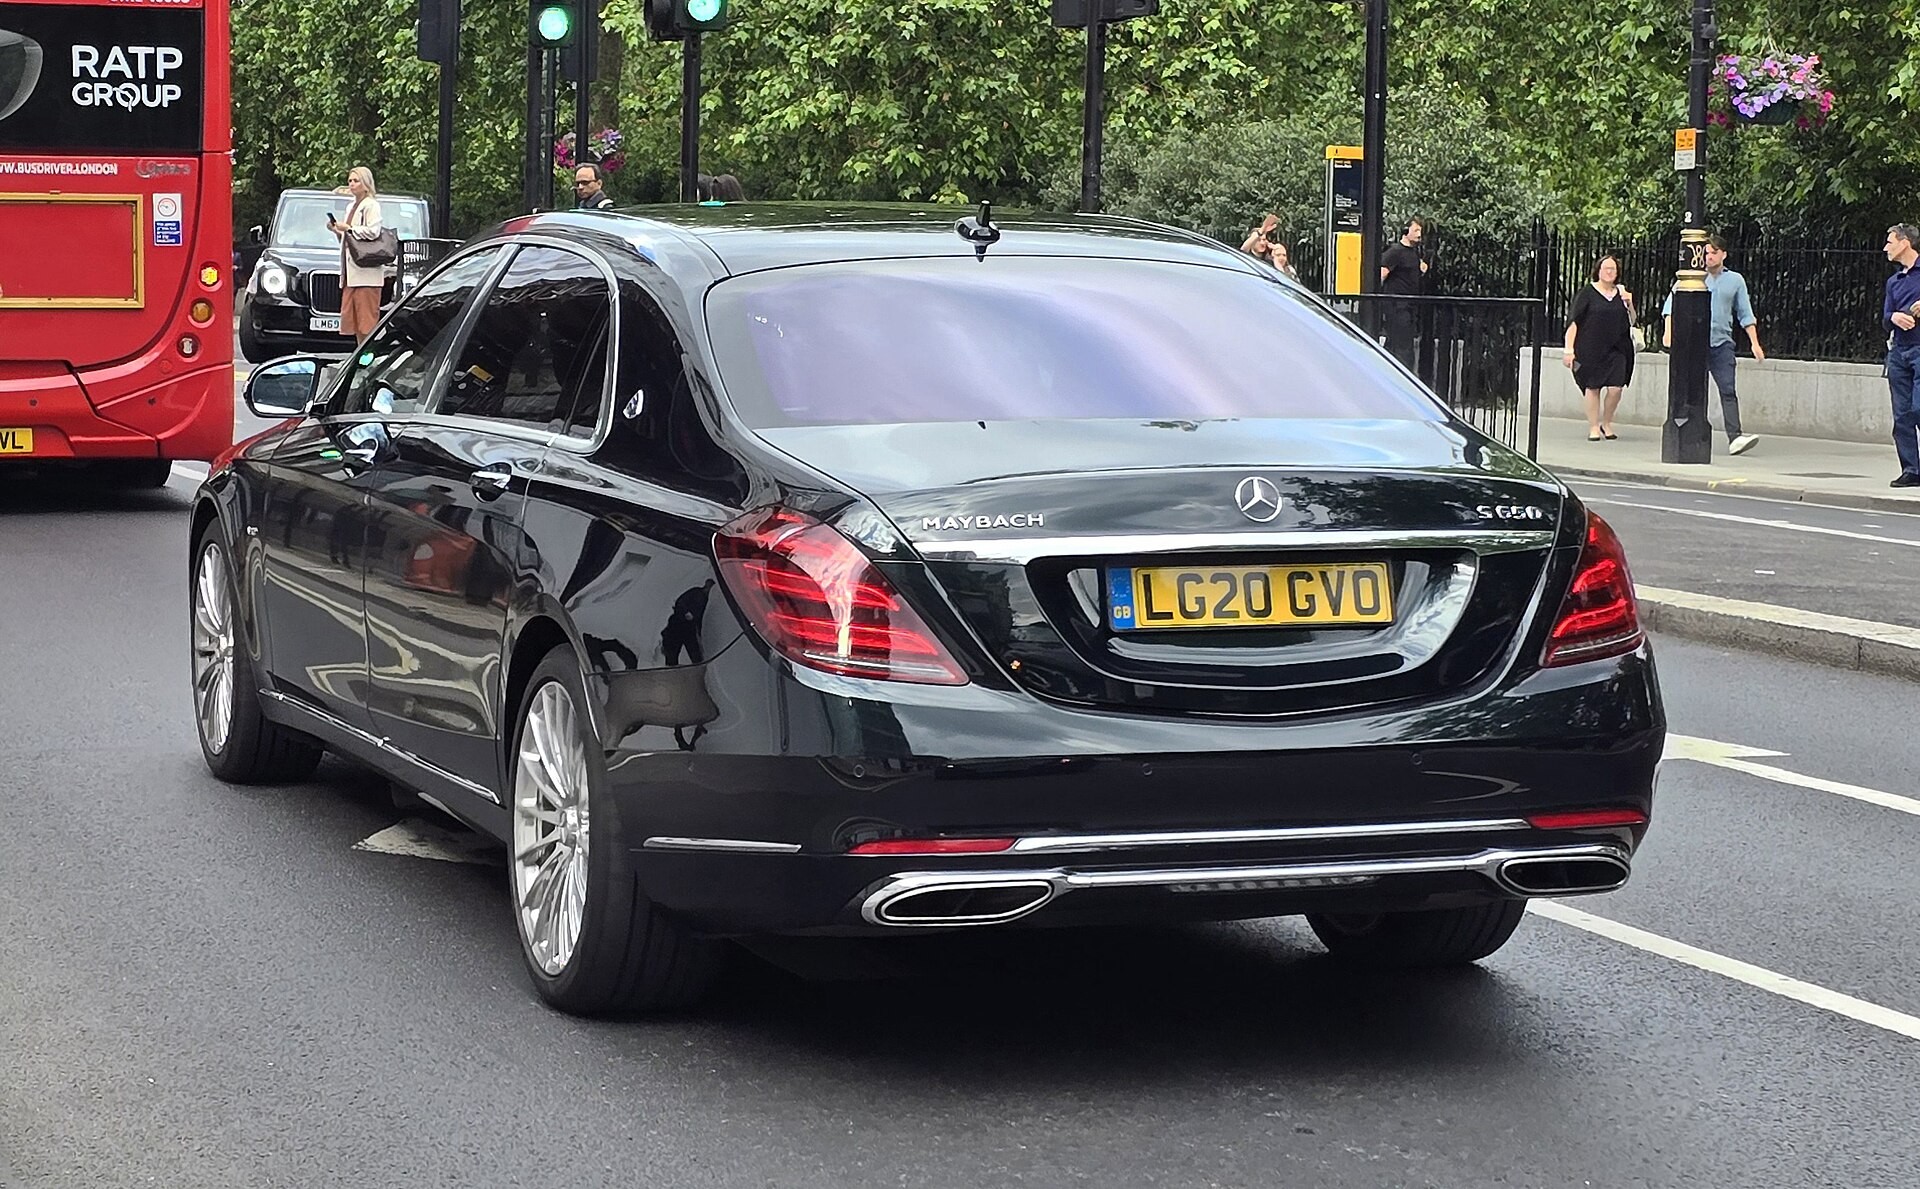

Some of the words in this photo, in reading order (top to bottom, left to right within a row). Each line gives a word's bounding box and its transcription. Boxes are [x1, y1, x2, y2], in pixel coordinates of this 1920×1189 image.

[71, 44, 183, 80] RATP
[71, 82, 182, 113] GROUP
[921, 513, 1044, 531] MAYBACH
[1476, 505, 1494, 520] S
[1142, 571, 1273, 621] LG20
[1286, 569, 1381, 617] GVO
[1113, 605, 1132, 619] GB
